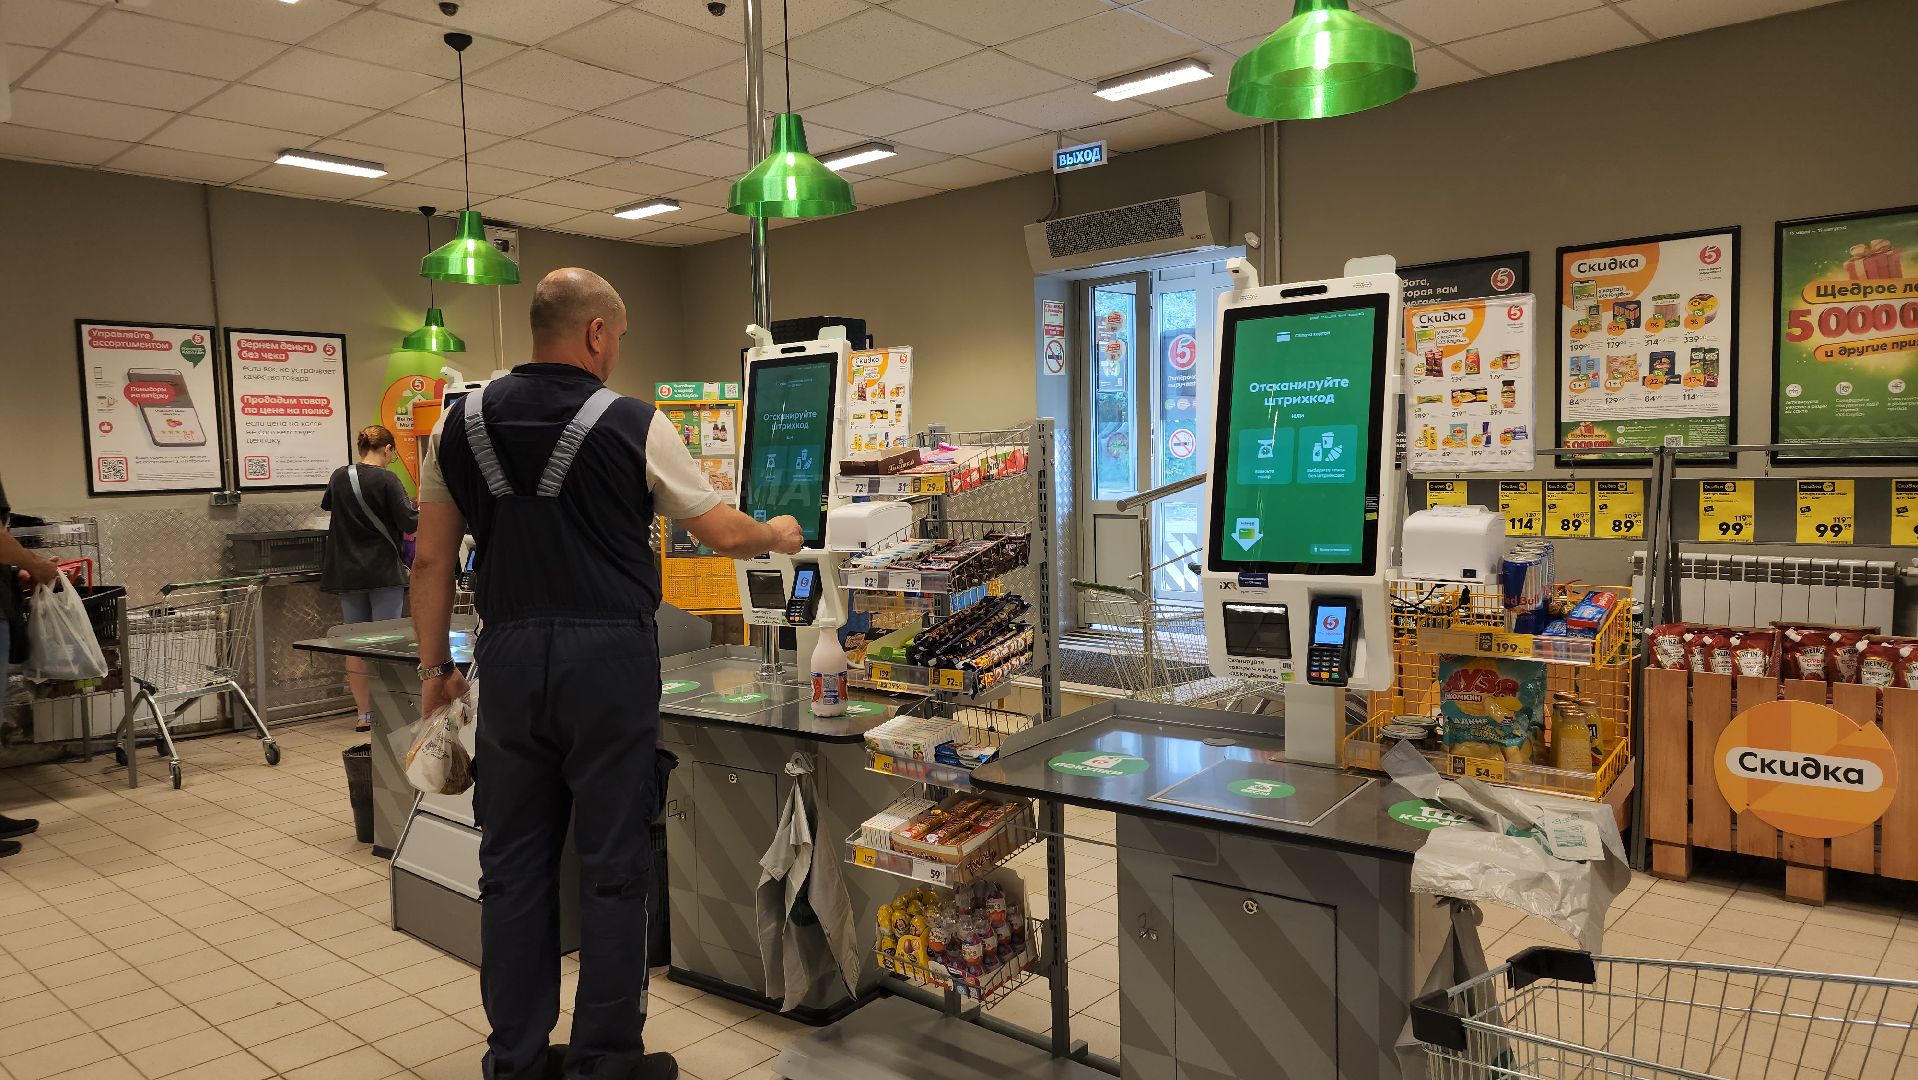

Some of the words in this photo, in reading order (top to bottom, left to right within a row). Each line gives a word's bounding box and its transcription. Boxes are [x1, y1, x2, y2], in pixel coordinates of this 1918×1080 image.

[1059, 147, 1100, 167] ВЫХОД
[1577, 258, 1640, 274] Скидка
[1436, 286, 1458, 295] вам
[1815, 282, 1897, 298] Щедрое
[1419, 311, 1466, 324] Скидка
[1785, 308, 1815, 343] 5
[91, 329, 151, 341] Управляйте
[92, 339, 171, 351] ассортиментом
[241, 340, 280, 350] Вернем
[280, 341, 314, 353] деньги
[1825, 349, 1834, 357] и
[1838, 344, 1887, 358] другие
[242, 350, 260, 359] без
[261, 352, 286, 361] чека
[855, 356, 880, 365] Скидка
[1249, 376, 1350, 393] Отсканируйте
[244, 395, 297, 406] Продадим
[299, 397, 329, 406] товар
[1264, 393, 1336, 408] штрихкод
[245, 406, 258, 414] по
[260, 406, 286, 417] цене
[287, 407, 300, 415] на
[302, 407, 331, 416] полке
[763, 409, 817, 422] Отсканируйте
[772, 421, 809, 431] штрихкод
[855, 483, 864, 493] 72
[927, 483, 936, 492] 29
[1509, 518, 1534, 531] 114
[1560, 518, 1582, 531] 89
[1612, 519, 1635, 532] 89
[1718, 522, 1743, 536] 99
[1815, 523, 1843, 537] 99
[906, 578, 916, 588] 59
[1496, 643, 1518, 653] 199
[1657, 638, 1681, 647] HEINZ
[1864, 659, 1889, 670] HEINZ
[946, 677, 955, 686] 72
[1475, 768, 1490, 778] 54
[1738, 751, 1865, 785] Скидка
[930, 869, 941, 879] 59
